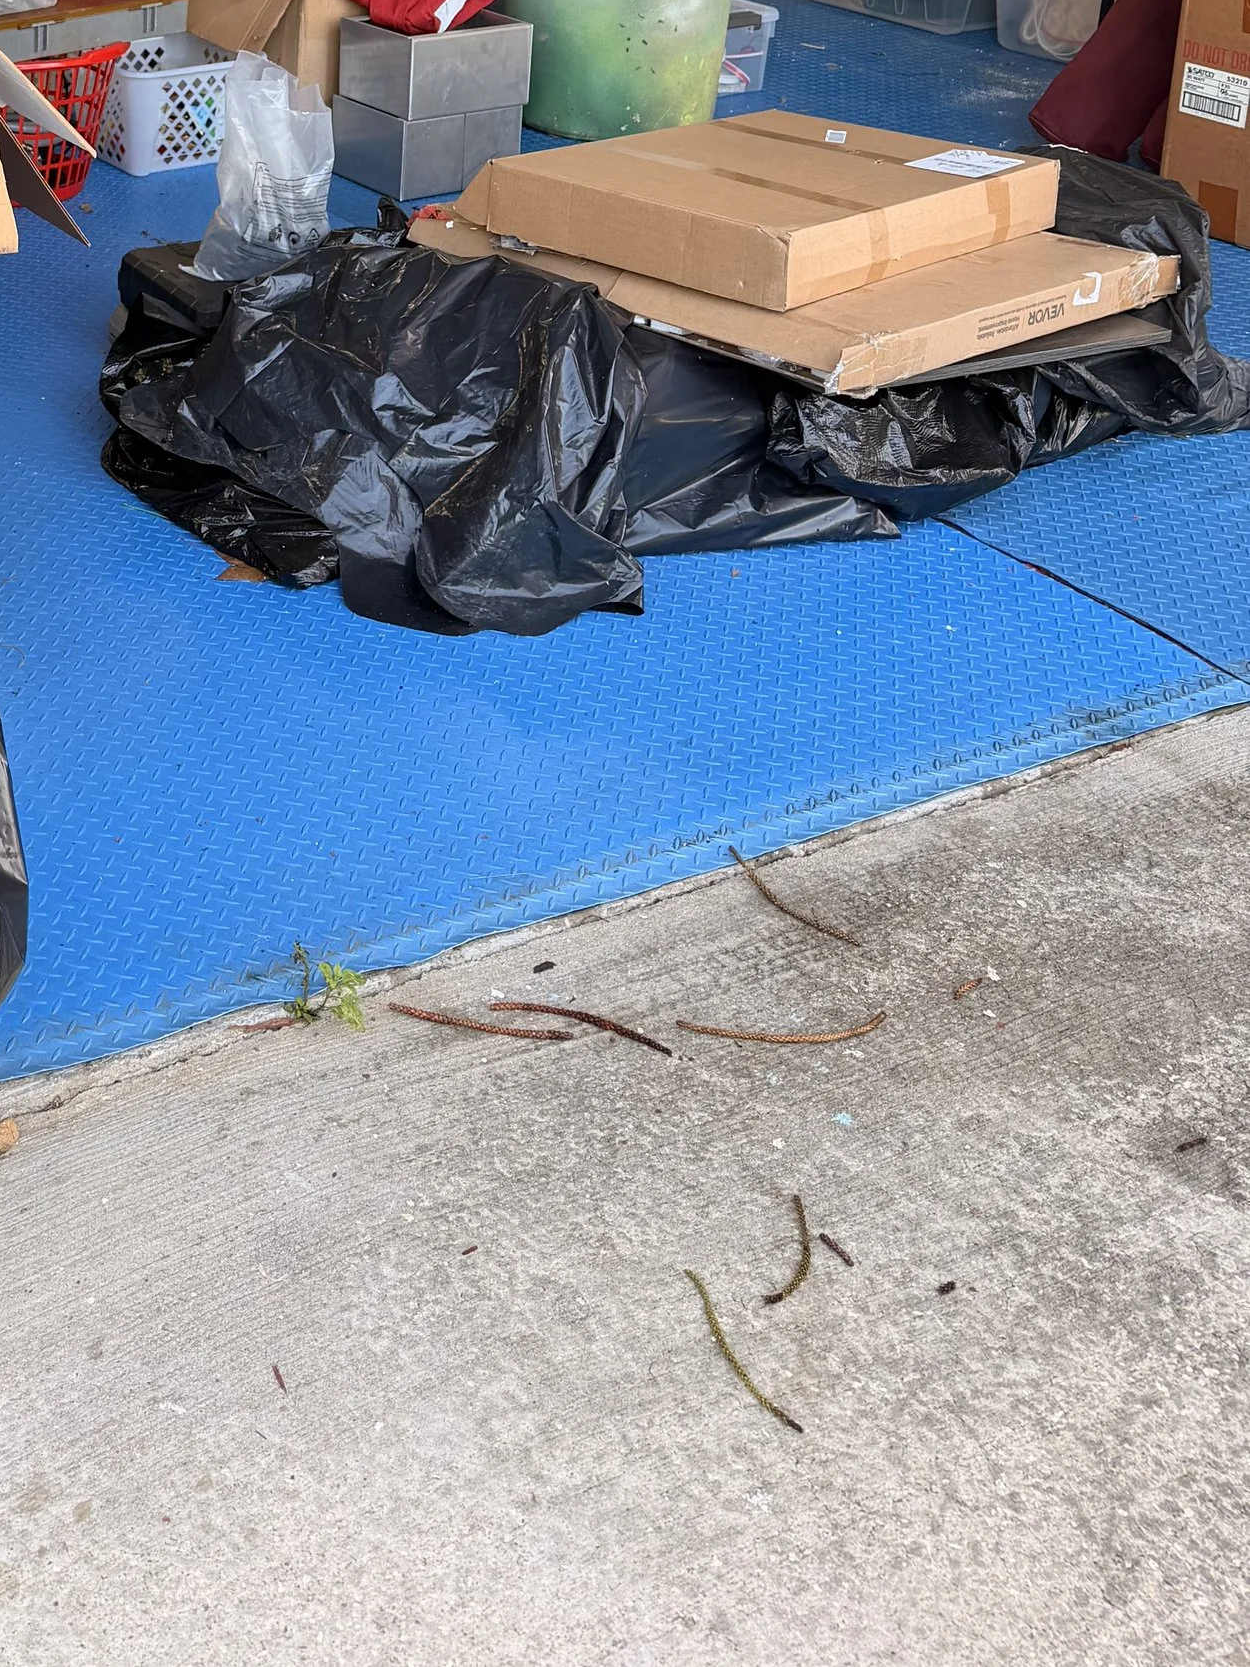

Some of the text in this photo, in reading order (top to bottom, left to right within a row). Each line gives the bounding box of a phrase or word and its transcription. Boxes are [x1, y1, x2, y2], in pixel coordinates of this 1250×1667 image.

[1182, 39, 1200, 61] DO
[1203, 44, 1229, 67] NOT
[1027, 302, 1065, 326] VEVOR
